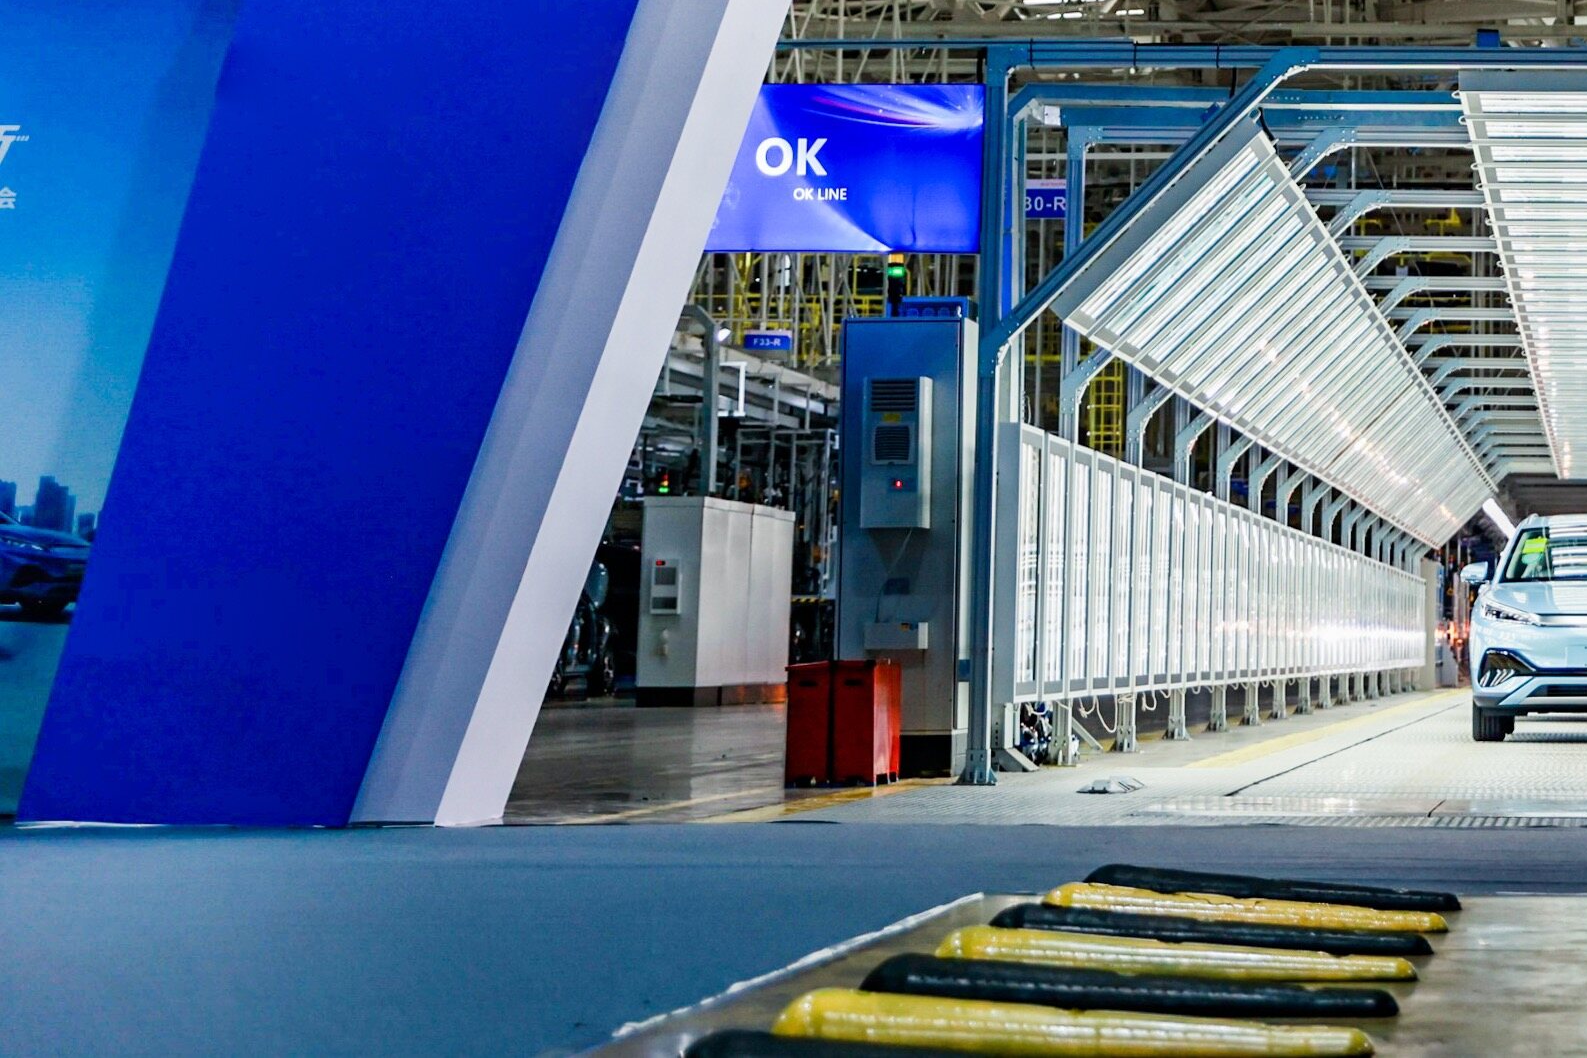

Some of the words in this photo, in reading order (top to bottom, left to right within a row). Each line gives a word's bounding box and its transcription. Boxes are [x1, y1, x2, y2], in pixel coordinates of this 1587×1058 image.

[756, 137, 828, 176] OK
[793, 188, 814, 201] OK
[817, 188, 848, 201] LINE
